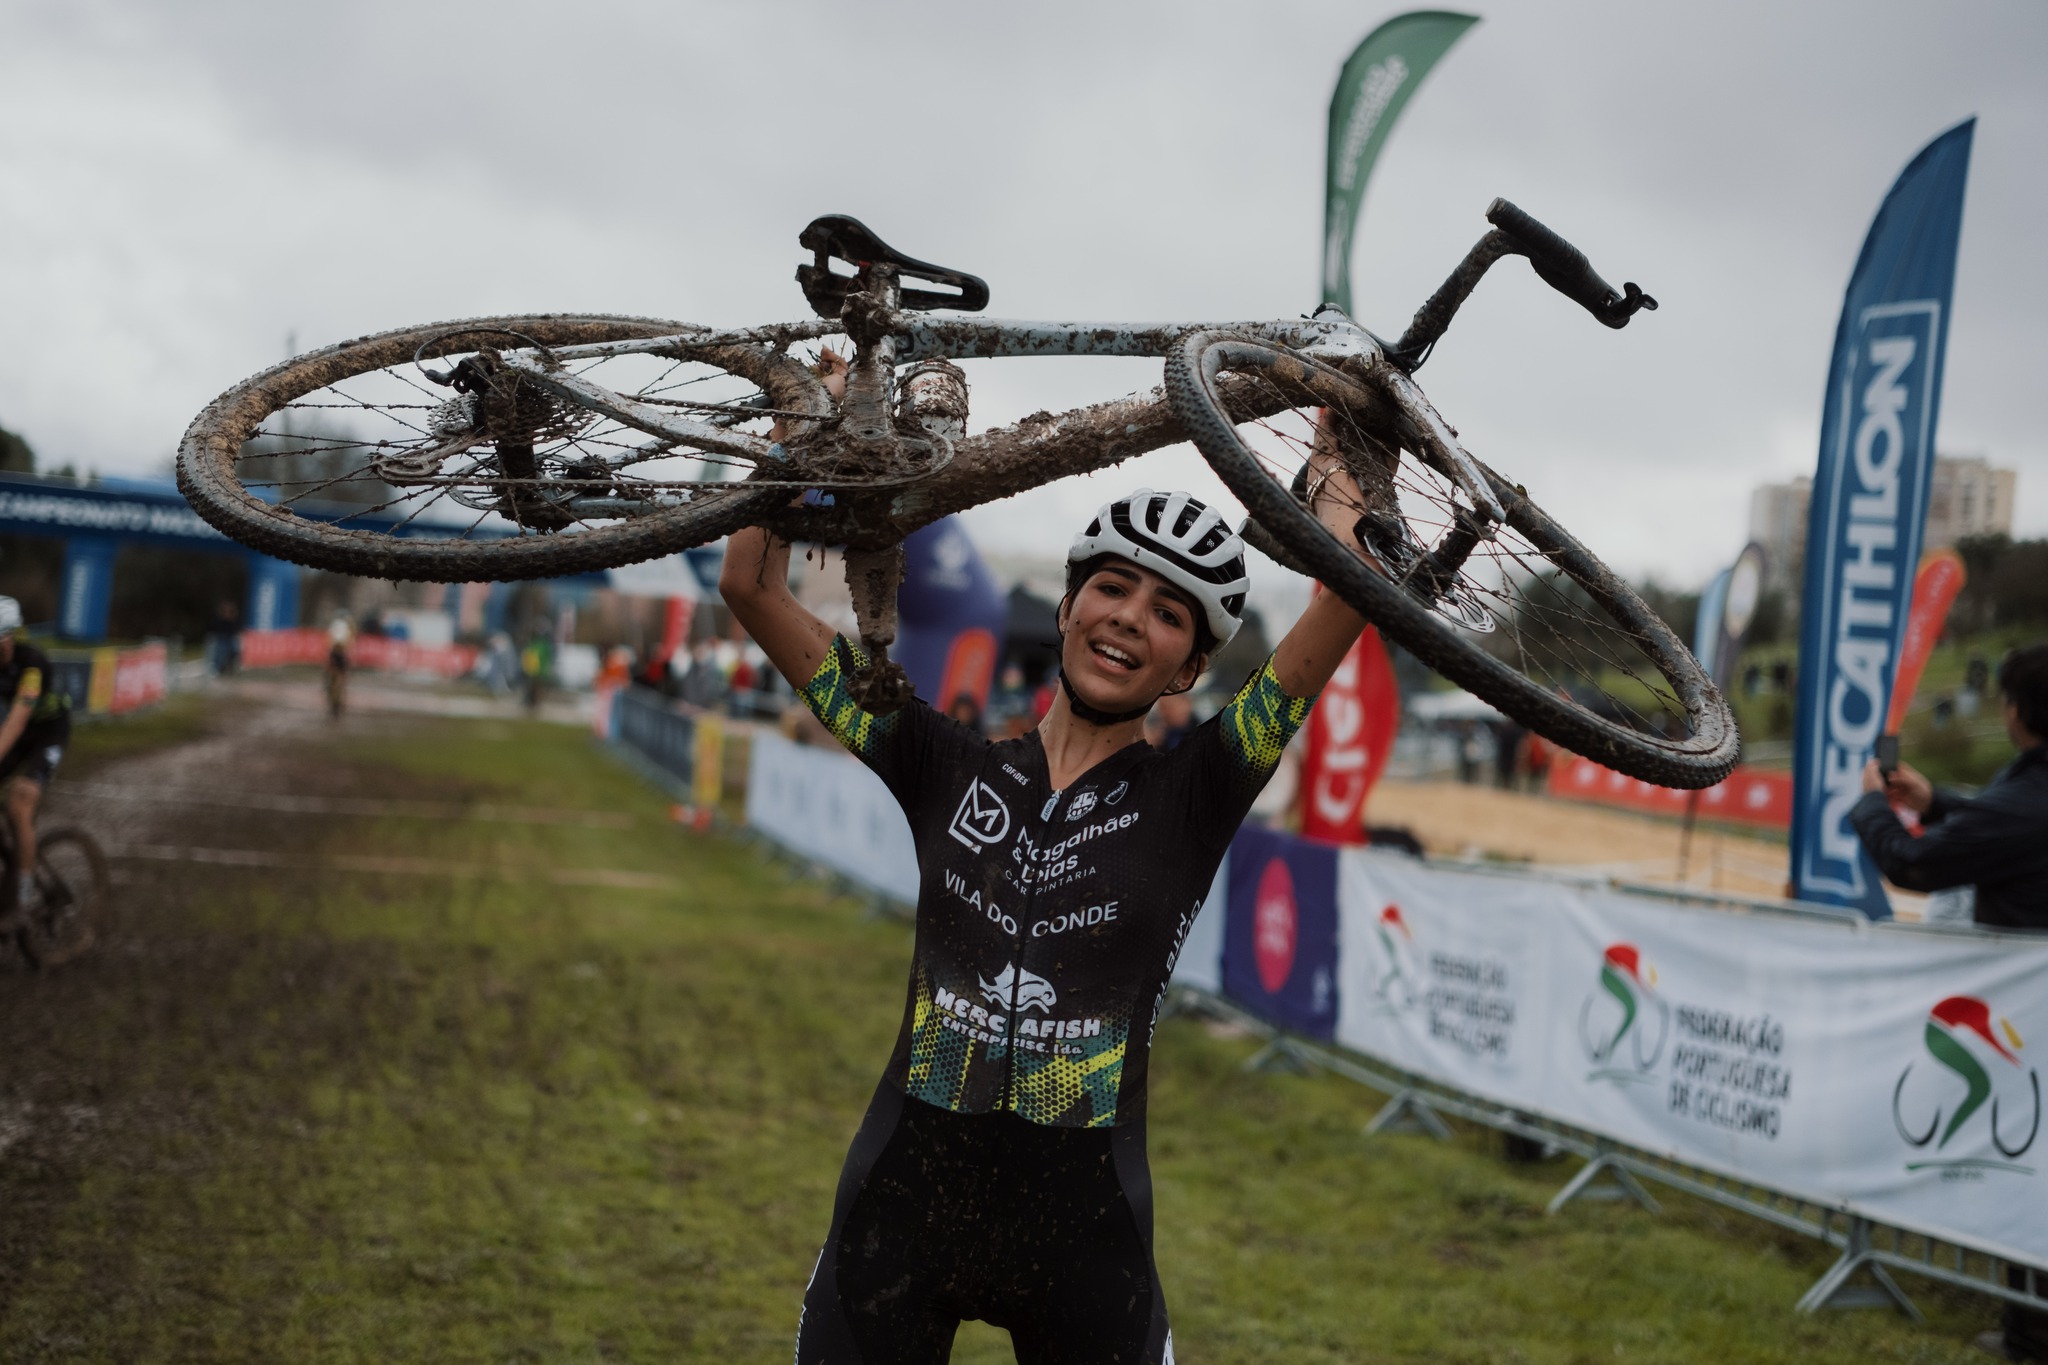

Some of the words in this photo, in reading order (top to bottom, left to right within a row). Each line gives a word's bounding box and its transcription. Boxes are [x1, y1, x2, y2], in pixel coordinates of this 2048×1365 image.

[945, 869, 981, 912] VILA
[987, 902, 1018, 936] DO
[1031, 901, 1119, 938] CONDE
